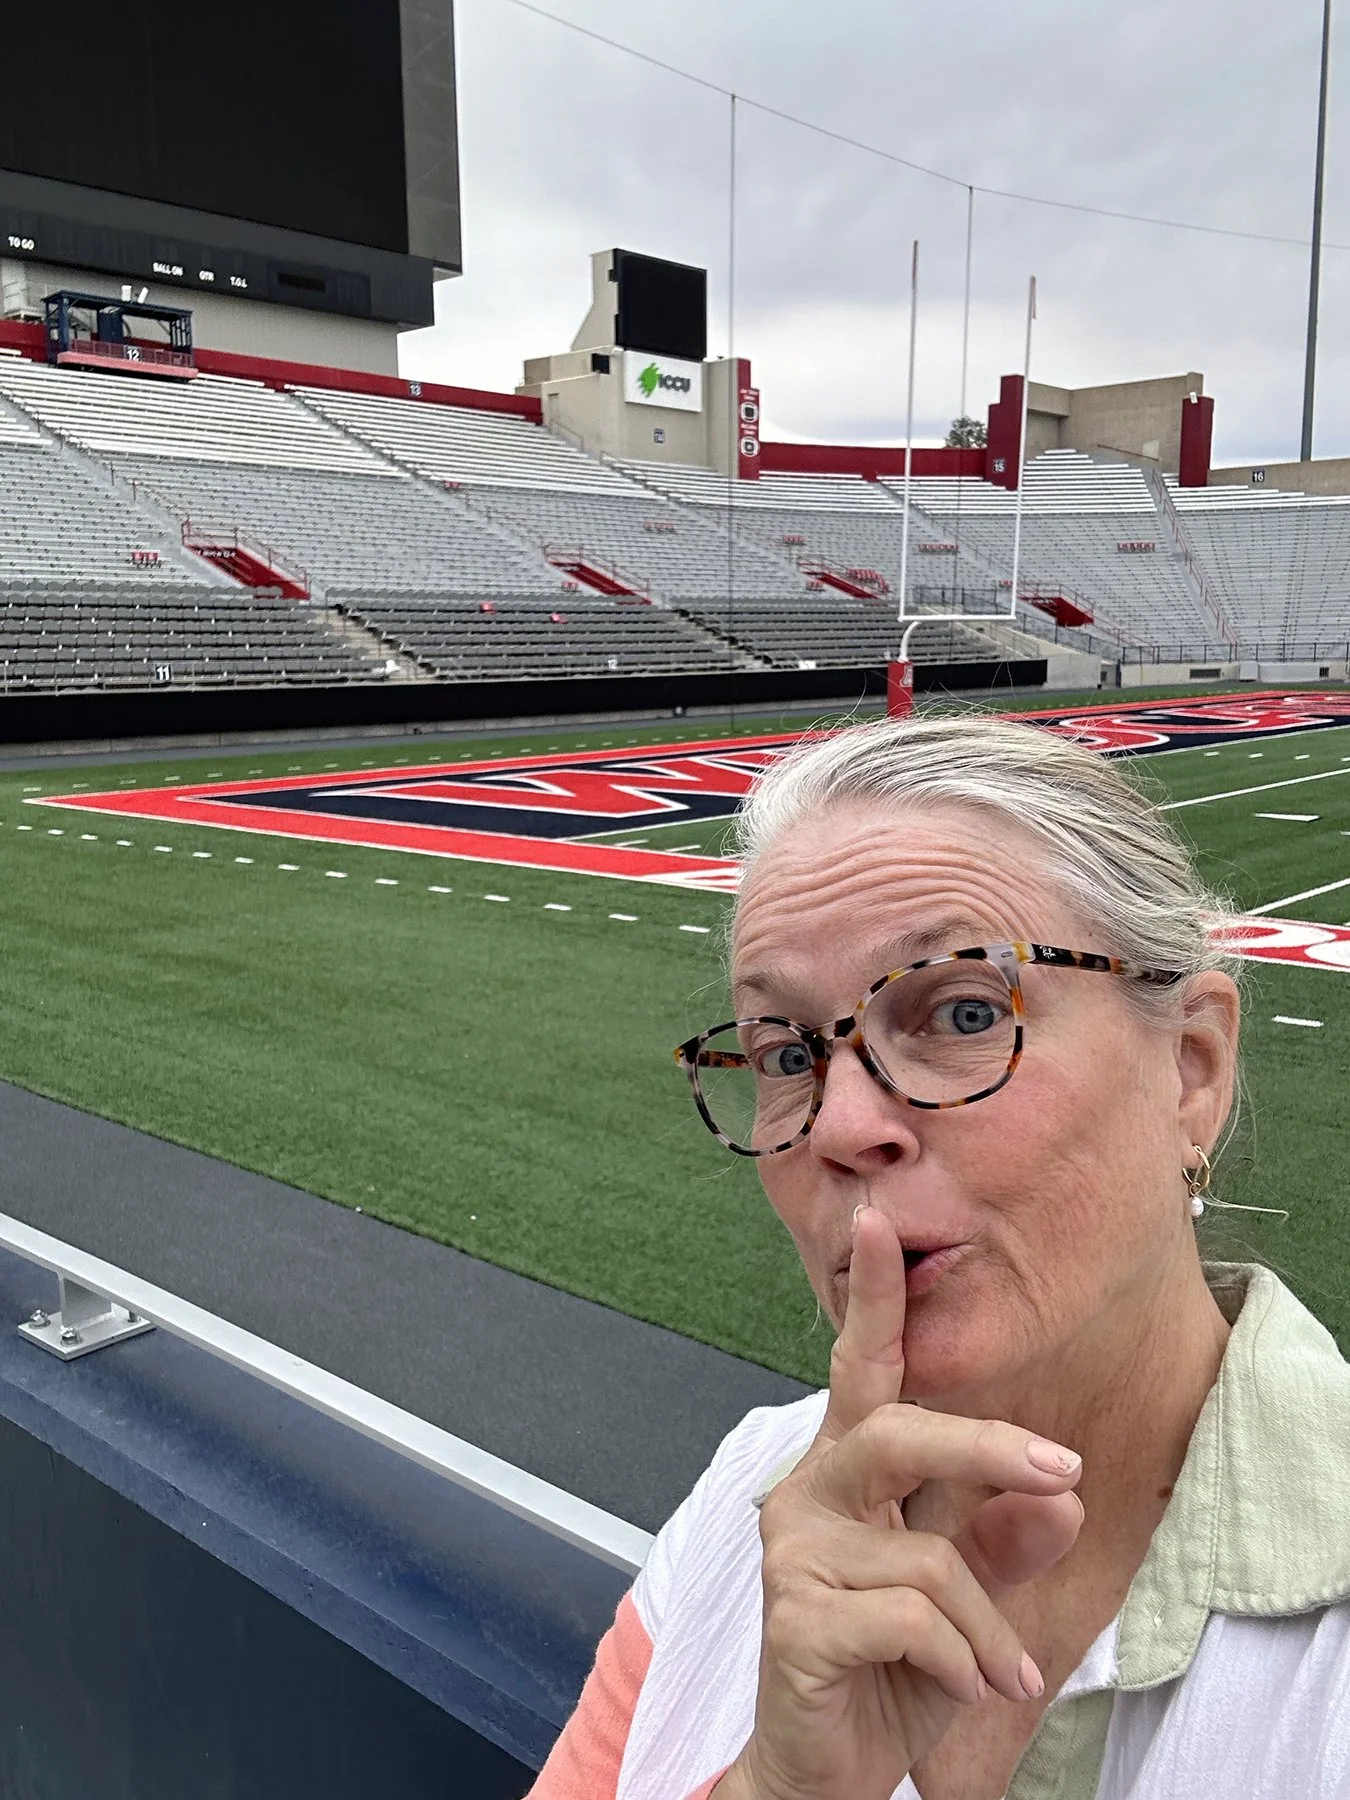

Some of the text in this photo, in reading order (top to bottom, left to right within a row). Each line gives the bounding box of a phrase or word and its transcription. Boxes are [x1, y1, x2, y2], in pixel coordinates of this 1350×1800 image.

[8, 236, 35, 250] TO GO
[153, 262, 171, 275] BALL
[127, 349, 140, 361] 12
[659, 374, 691, 393] ICCU
[994, 462, 1005, 472] 15
[1253, 472, 1264, 482] 16
[156, 666, 170, 681] 11
